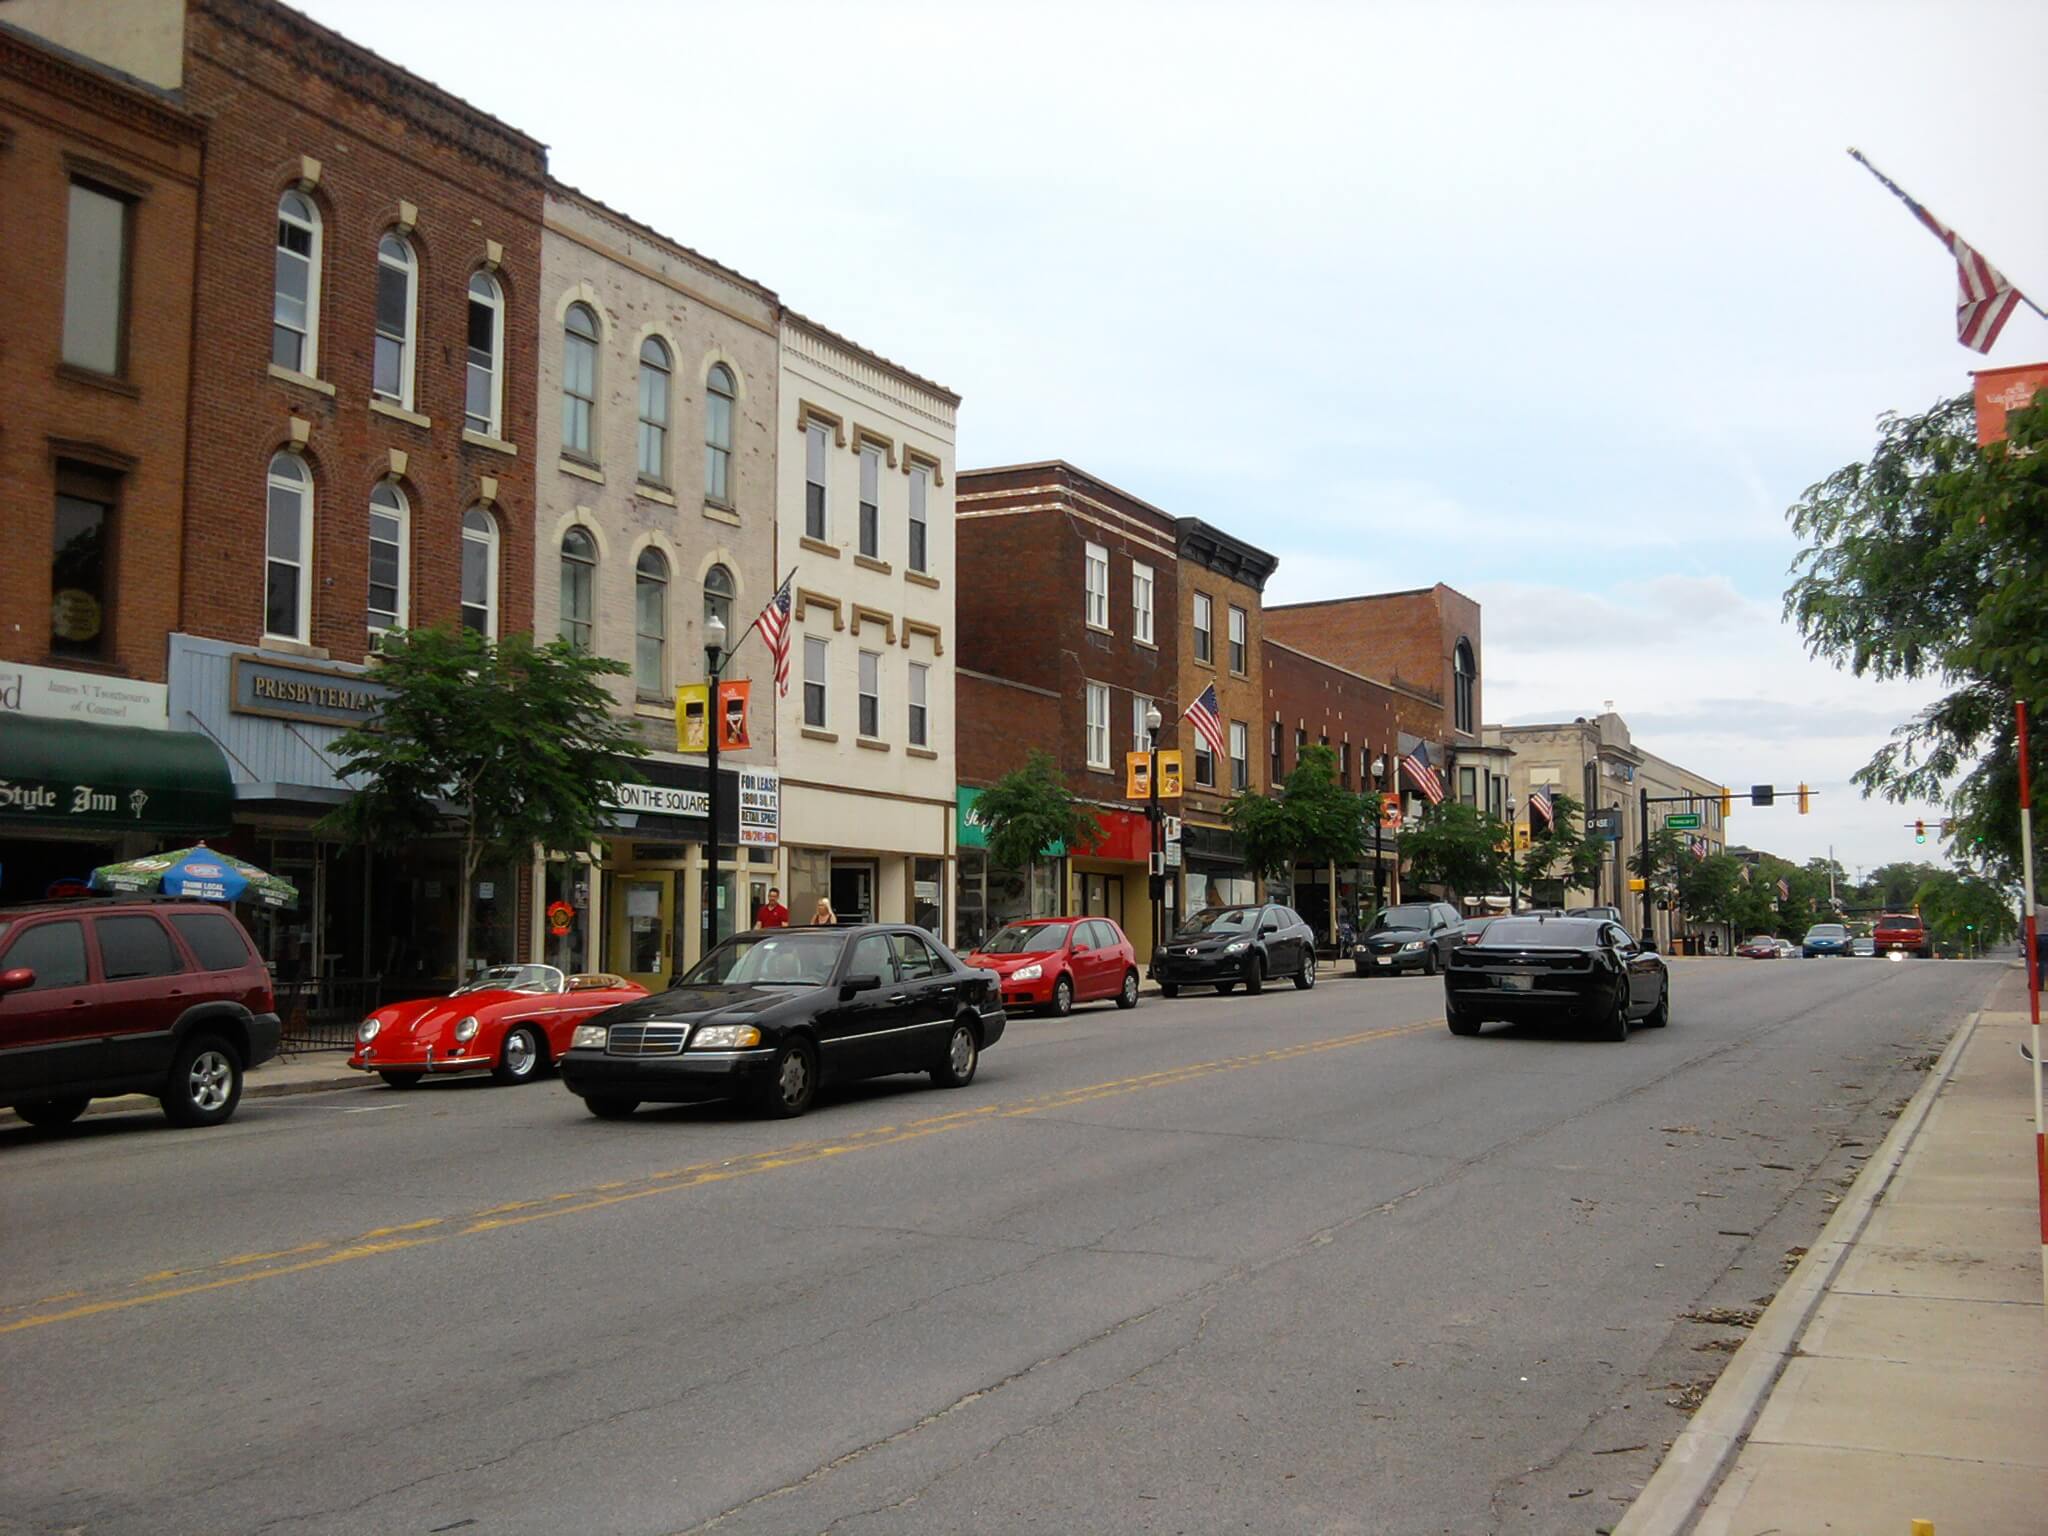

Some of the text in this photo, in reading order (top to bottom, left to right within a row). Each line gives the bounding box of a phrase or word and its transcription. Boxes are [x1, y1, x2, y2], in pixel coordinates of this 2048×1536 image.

[254, 676, 378, 713] PRESBYTERIAN
[741, 774, 777, 793] FOR LEASE
[70, 785, 118, 814] Inn
[621, 787, 710, 813] ON THE SQUARE
